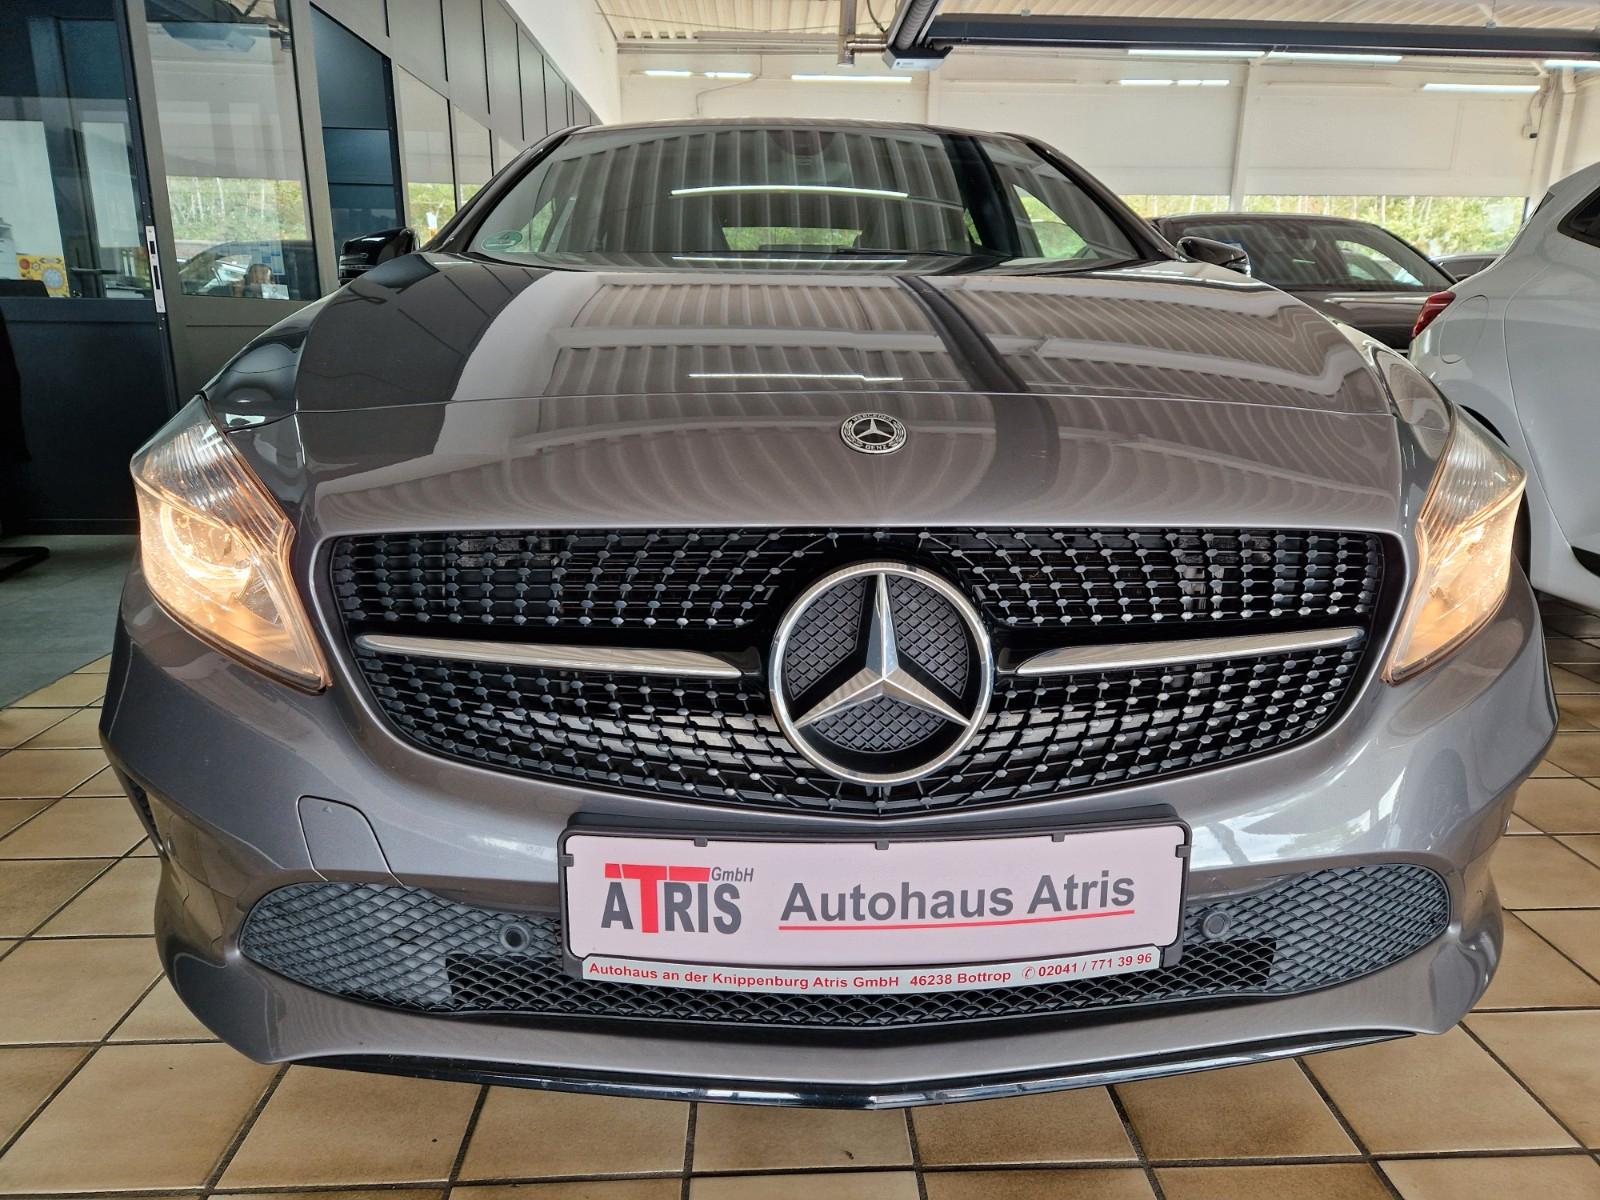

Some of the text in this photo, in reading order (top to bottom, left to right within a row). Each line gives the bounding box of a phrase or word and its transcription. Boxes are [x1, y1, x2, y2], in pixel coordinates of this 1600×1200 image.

[711, 867, 754, 883] GmbH
[780, 870, 1136, 922] Autohaus Atris
[601, 863, 742, 934] ATRIS
[589, 953, 1152, 989] Autohaus an der Knippenburg Atris GmbH 46238 Bottrop 02041 / 771 39 96
